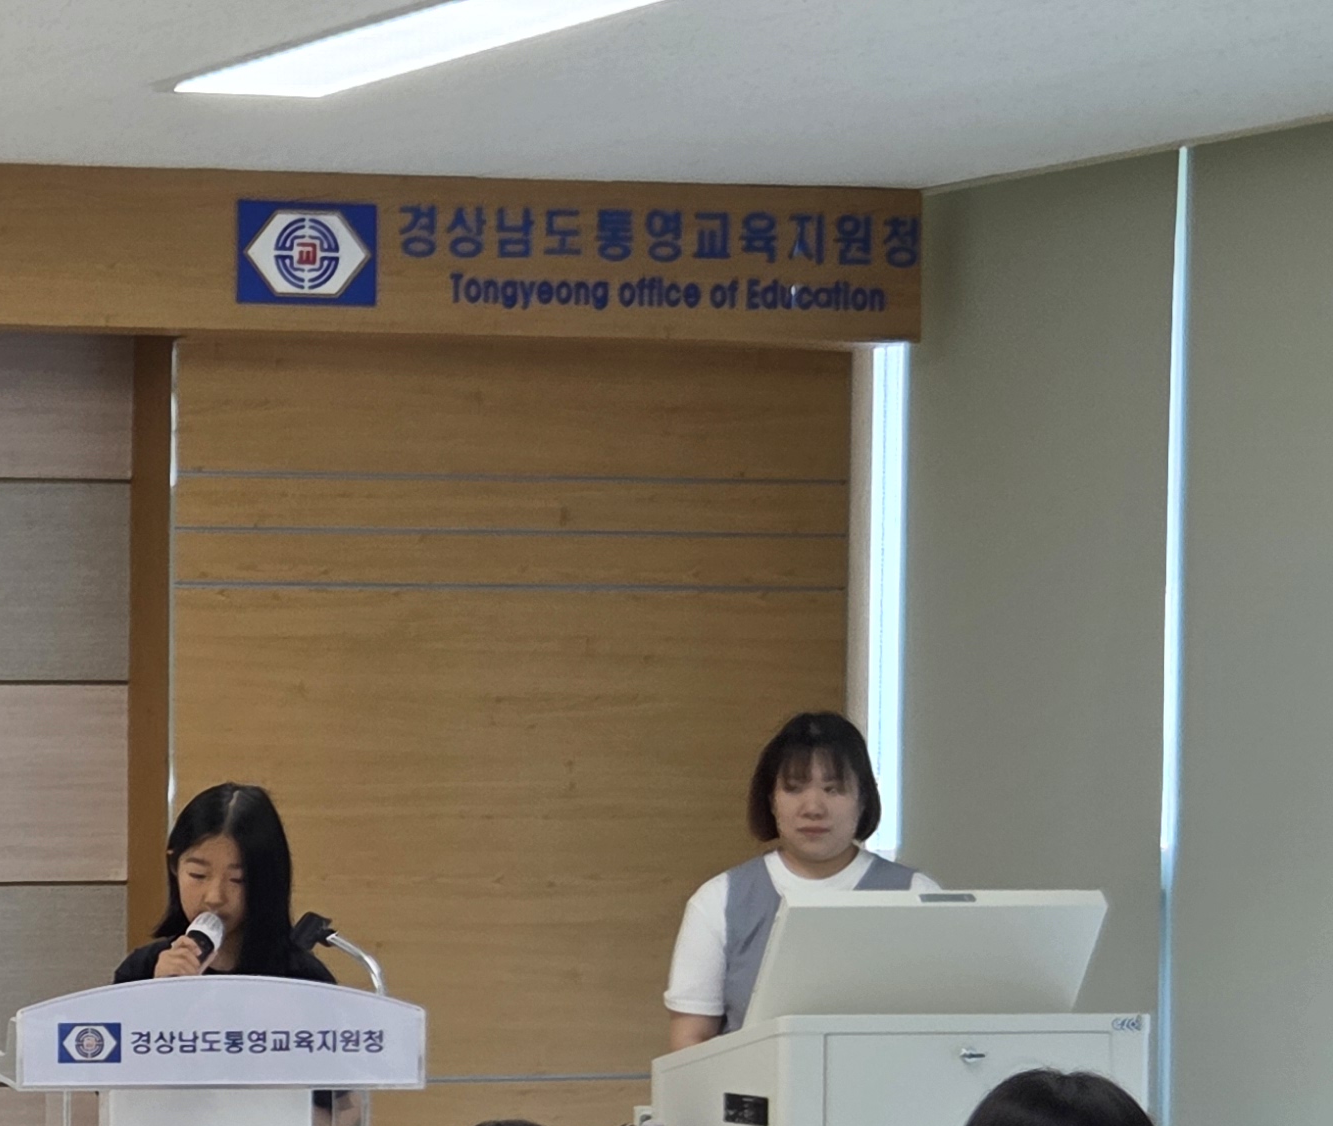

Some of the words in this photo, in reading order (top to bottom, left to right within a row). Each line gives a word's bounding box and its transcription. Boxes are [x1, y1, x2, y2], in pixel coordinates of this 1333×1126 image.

[398, 204, 921, 269] 경상남도통영교육지원청
[449, 271, 610, 311] Tongyeong
[618, 276, 702, 309] office
[709, 278, 739, 310] of
[746, 277, 888, 312] Education
[130, 1029, 385, 1055] 경상남도통영교육지원청
